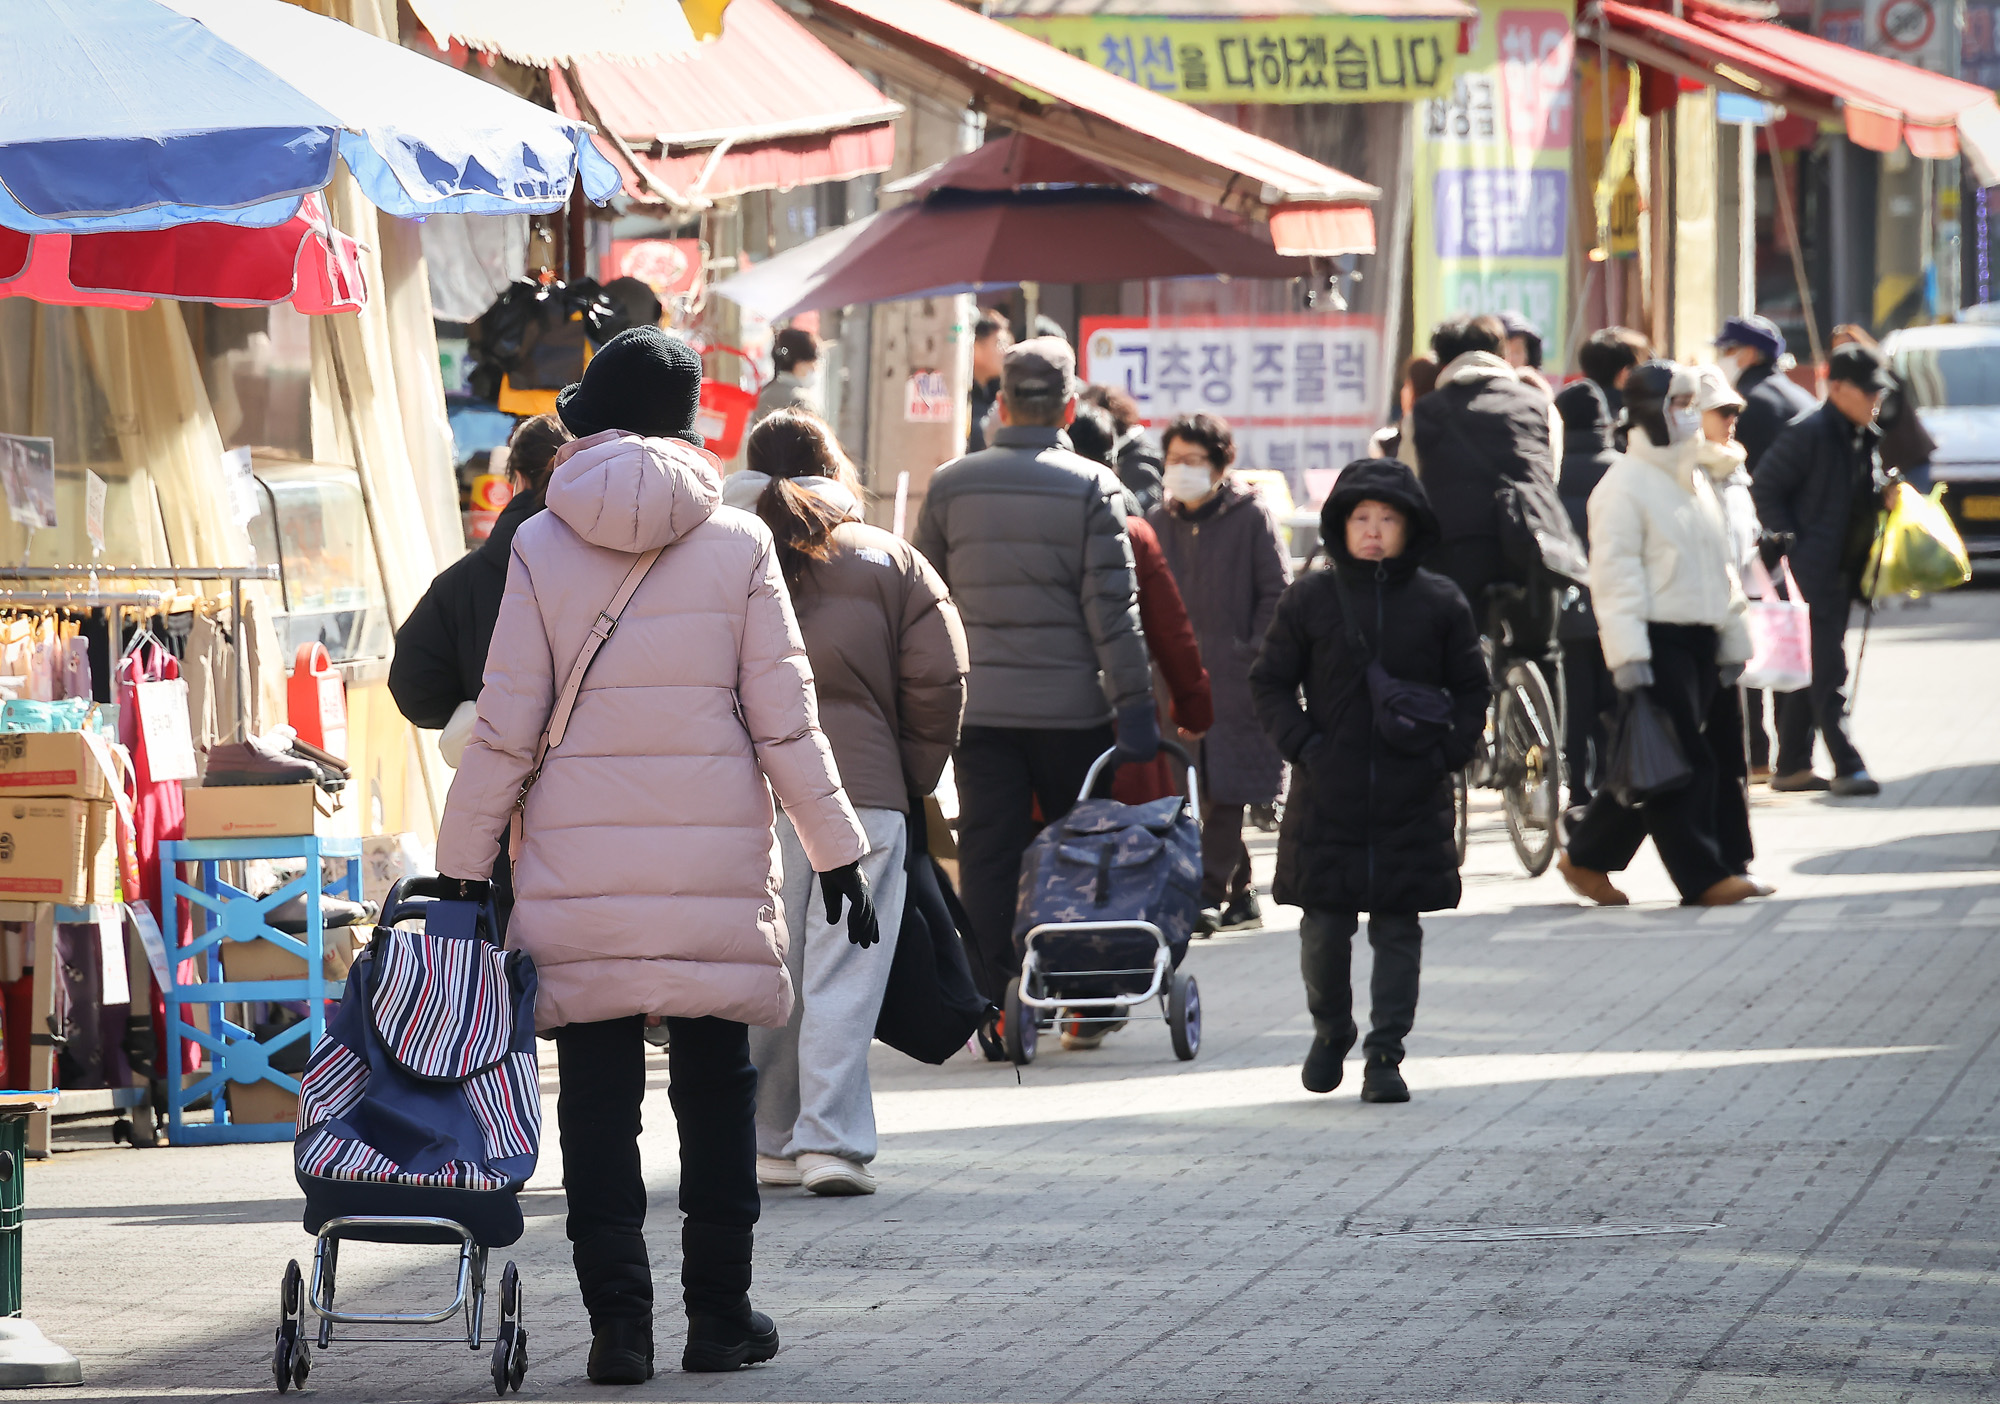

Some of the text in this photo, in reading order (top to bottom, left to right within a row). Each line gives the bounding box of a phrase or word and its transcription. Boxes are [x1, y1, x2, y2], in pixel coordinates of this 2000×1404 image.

[1099, 34, 1444, 91] 최선을 다하겠습니다
[1117, 341, 1367, 404] 고추장 주물럭
